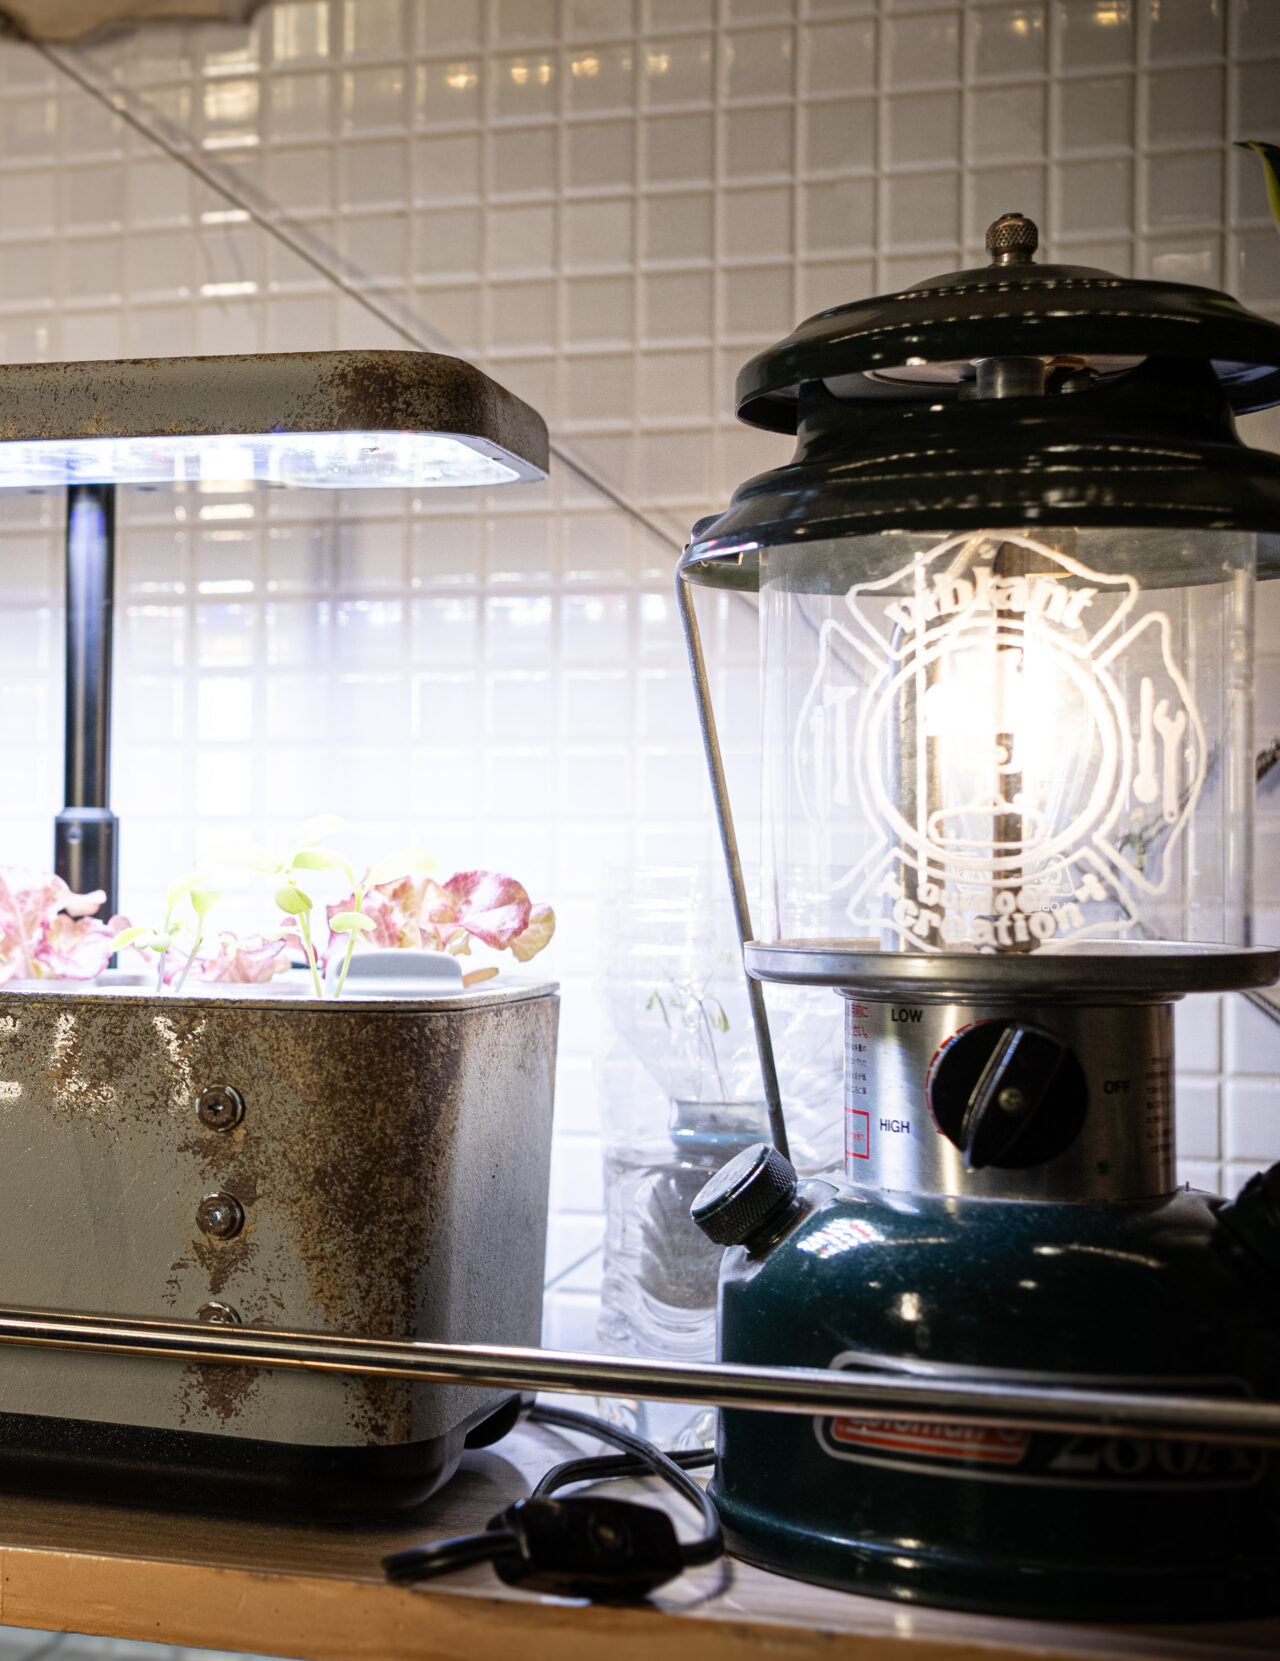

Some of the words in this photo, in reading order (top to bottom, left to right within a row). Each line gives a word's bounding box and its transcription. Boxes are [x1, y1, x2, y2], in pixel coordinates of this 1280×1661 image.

[893, 898, 1086, 946] creation
[891, 1008, 924, 1022] LOW
[1103, 1080, 1131, 1095] OFF
[879, 1118, 911, 1133] HIGH
